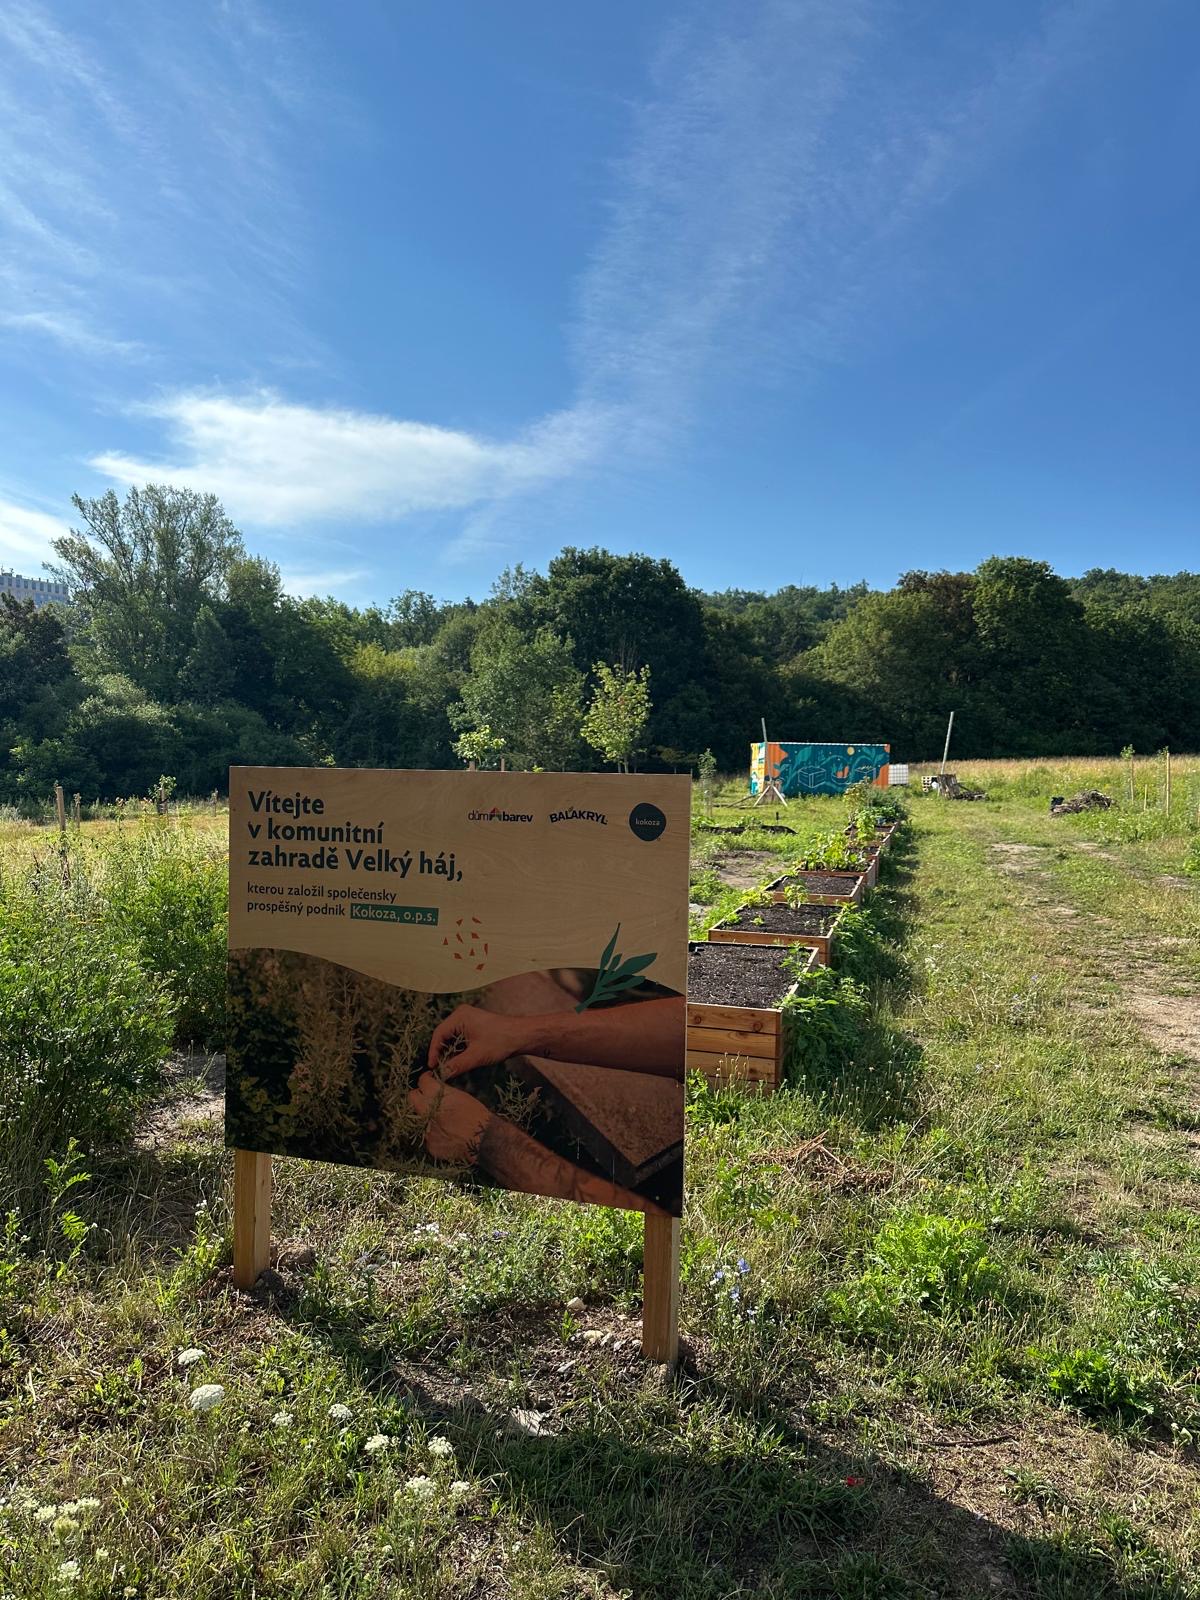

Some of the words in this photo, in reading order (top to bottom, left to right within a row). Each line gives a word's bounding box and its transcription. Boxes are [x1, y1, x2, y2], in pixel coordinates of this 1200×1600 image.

[248, 790, 324, 820] Vítejte
[468, 808, 489, 822] dům
[502, 810, 533, 823] barev
[248, 821, 261, 840] v
[267, 817, 384, 844] komunitní
[635, 817, 660, 827] kokoza
[248, 844, 339, 870] zahradě
[345, 849, 413, 879] Velký
[419, 850, 463, 882] háj,
[247, 881, 284, 896] kterou
[287, 885, 324, 898] založil
[327, 886, 397, 904] společensky
[247, 901, 304, 916] prospěšný
[306, 903, 345, 917] podnik
[352, 905, 400, 922] Kokoza,
[403, 911, 436, 924] o.p.s.
